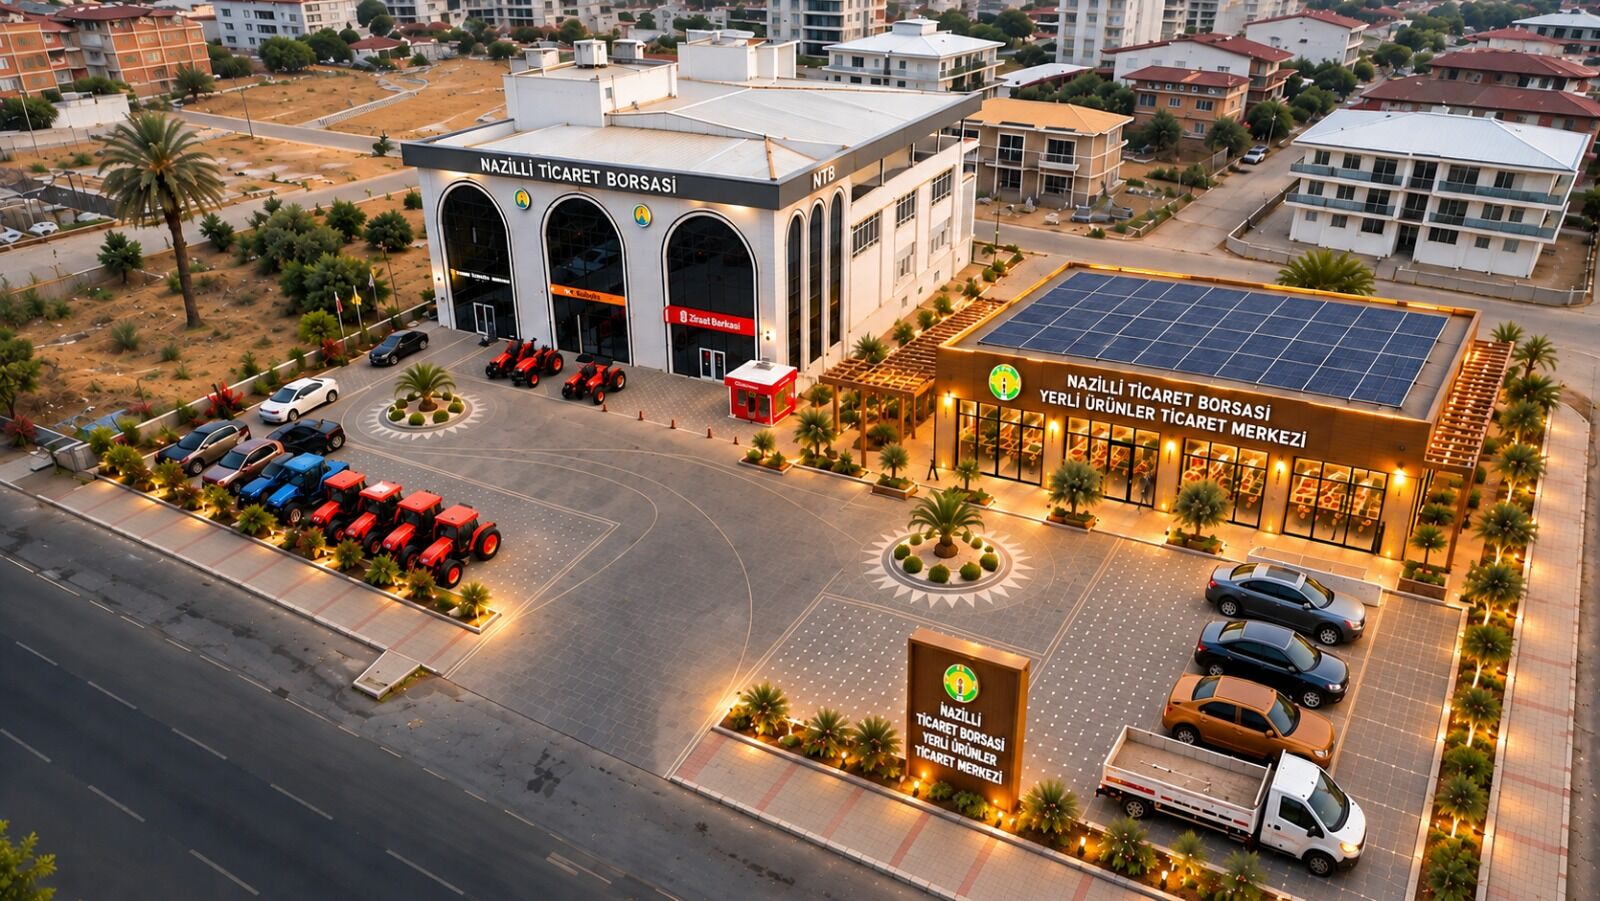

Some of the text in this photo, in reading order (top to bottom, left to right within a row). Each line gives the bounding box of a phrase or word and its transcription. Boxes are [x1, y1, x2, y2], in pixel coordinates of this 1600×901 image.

[480, 157, 677, 194] NAZİLLİ TİCARET BORSASİ
[813, 165, 835, 190] NTB
[1066, 373, 1272, 421] NAZİLLİ TİCARET BORSASİ
[1039, 389, 1308, 449] YERLİ ÜRÜNLER TİCARET MERKEZİ
[916, 712, 1006, 752] TİCARET BORSASİ
[922, 731, 950, 750] YERLİ
[915, 744, 1004, 785] TİCARET MERKEZİ
